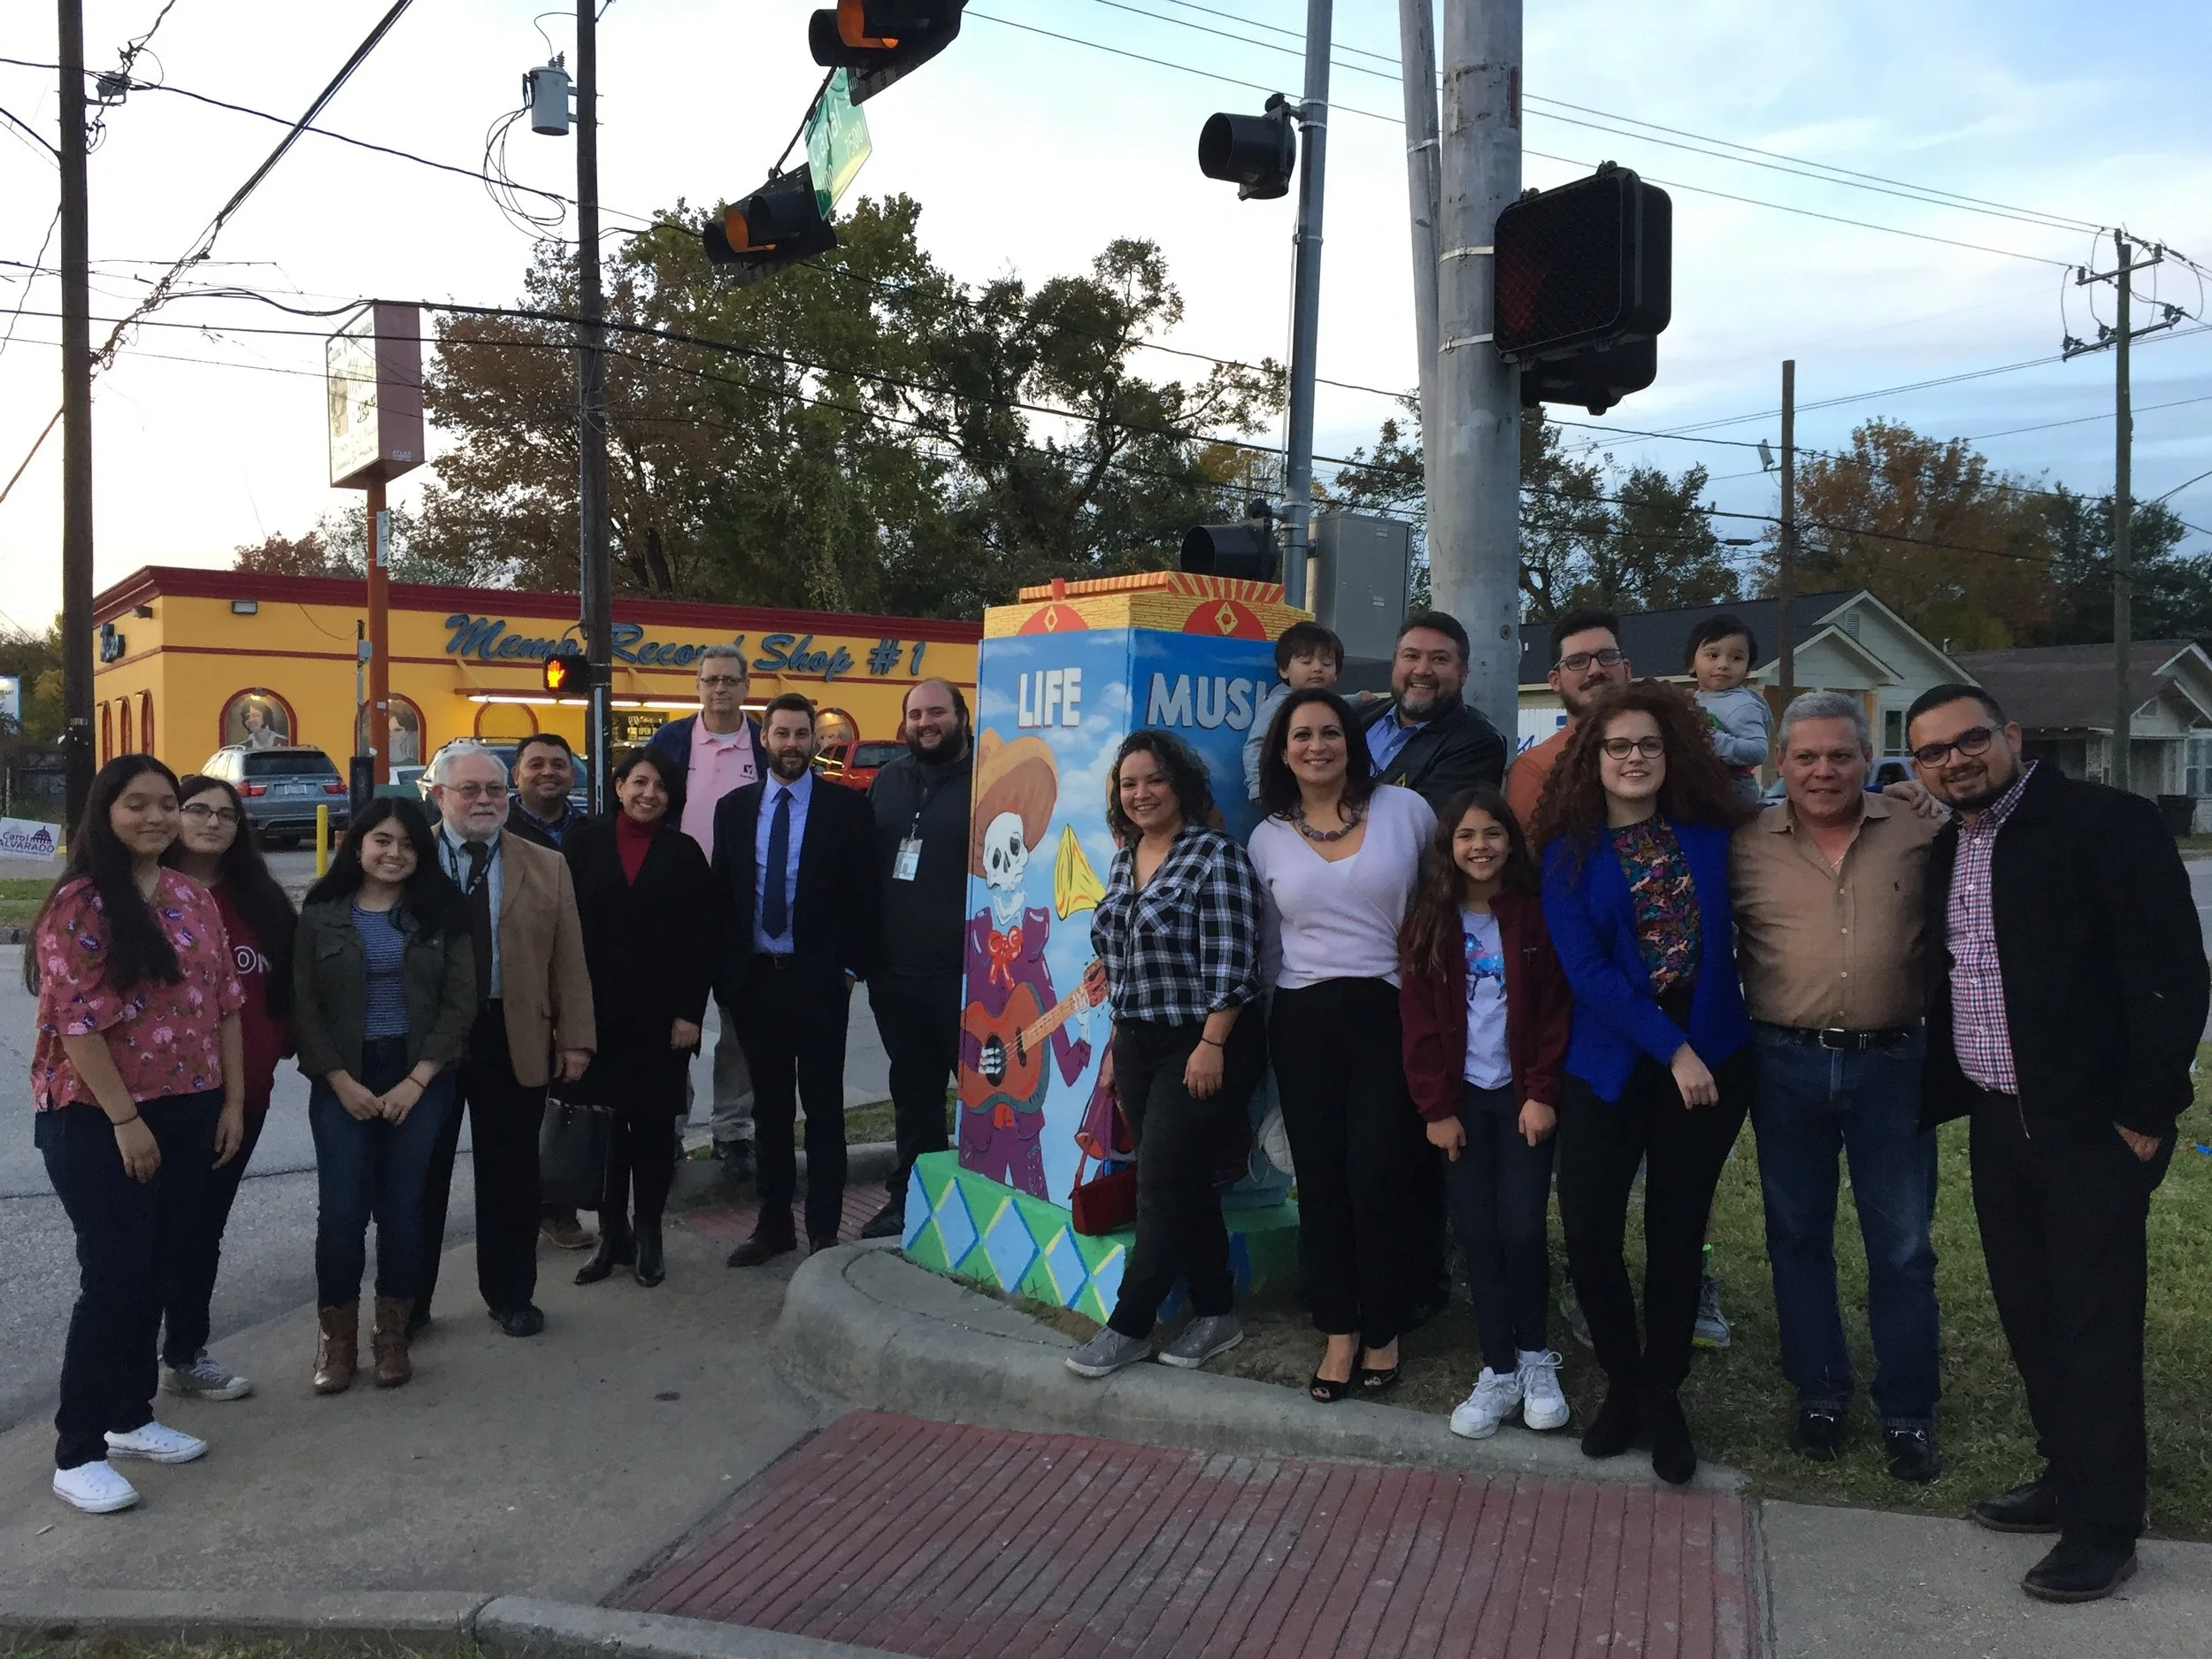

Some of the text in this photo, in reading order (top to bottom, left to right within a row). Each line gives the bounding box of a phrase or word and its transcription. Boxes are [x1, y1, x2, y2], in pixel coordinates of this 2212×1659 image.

[811, 96, 842, 167] Canal
[611, 623, 745, 666] Reco
[753, 634, 855, 682] Shop
[1018, 667, 1082, 729] LIFE
[3, 832, 29, 841] Carol
